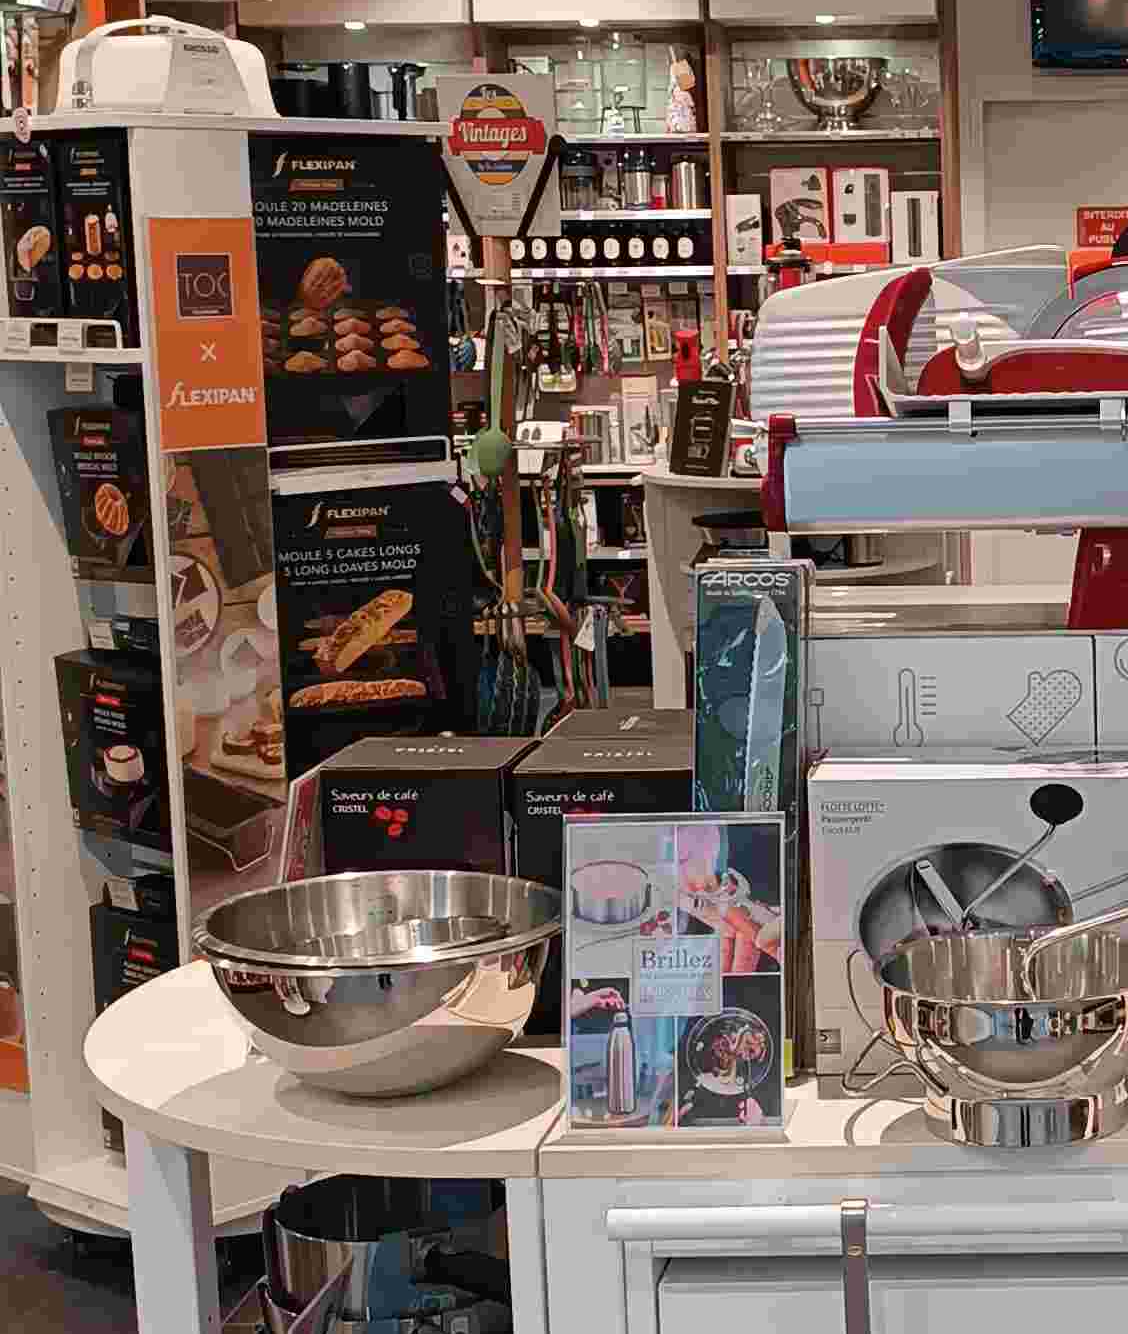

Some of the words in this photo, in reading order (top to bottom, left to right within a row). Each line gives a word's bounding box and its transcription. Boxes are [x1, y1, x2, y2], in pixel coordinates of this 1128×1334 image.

[458, 122, 527, 149] Vintages
[291, 159, 356, 171] FLEXIPAN
[255, 201, 288, 212] OULE
[292, 201, 306, 212] 20
[310, 200, 389, 212] MADELEINES
[267, 216, 345, 227] MADELEINES
[348, 216, 385, 227] MOLD
[1088, 234, 1120, 244] PUBL
[327, 506, 390, 519] FLEXIPAN
[278, 549, 323, 562] MOULE
[337, 546, 377, 559] CAKES
[379, 543, 421, 557] LONGS
[295, 564, 330, 576] LONG
[333, 561, 378, 574] LOAVES
[381, 558, 417, 570] MOLD
[701, 570, 792, 588] ARCOS
[331, 788, 374, 802] Saveurs
[377, 788, 391, 801] de
[394, 788, 419, 801] café
[525, 790, 569, 803] Saveurs
[572, 790, 588, 802] de
[590, 789, 616, 802] café
[641, 948, 713, 969] Brillez
